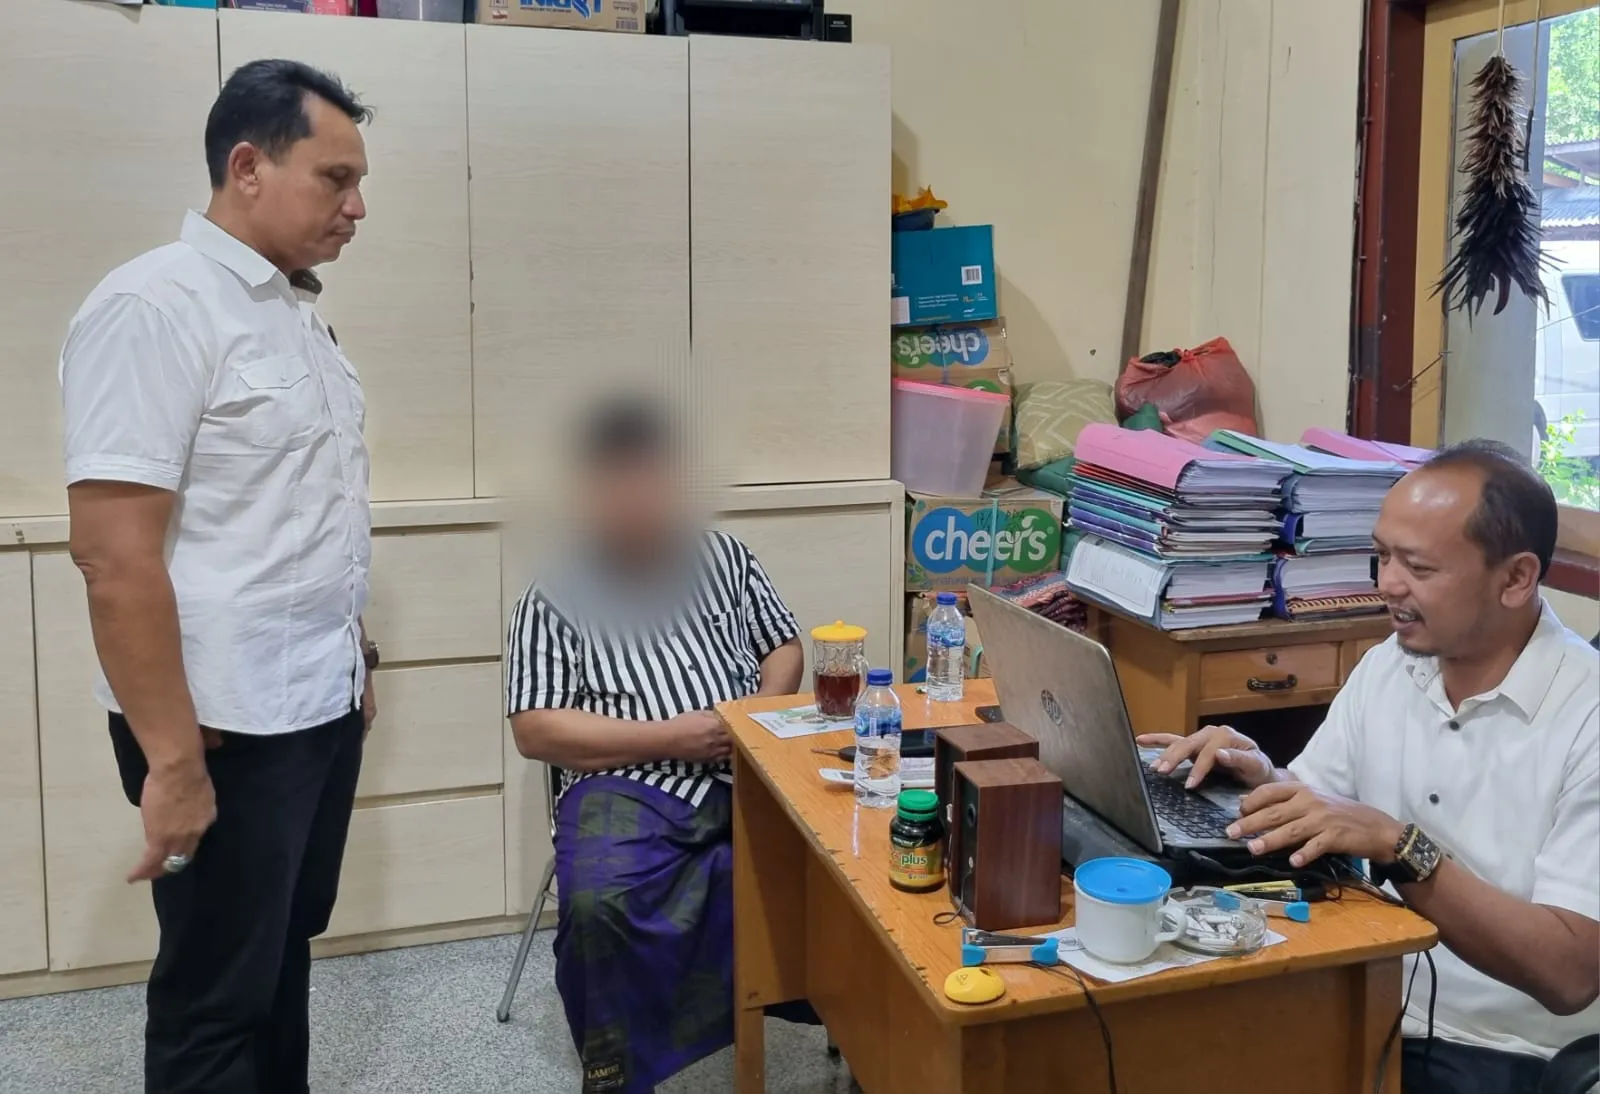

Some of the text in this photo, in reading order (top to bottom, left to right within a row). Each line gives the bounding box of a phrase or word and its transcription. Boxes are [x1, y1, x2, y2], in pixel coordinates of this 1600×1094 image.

[896, 332, 981, 362] cheers
[924, 515, 1048, 561] cheers
[900, 852, 929, 867] plus
